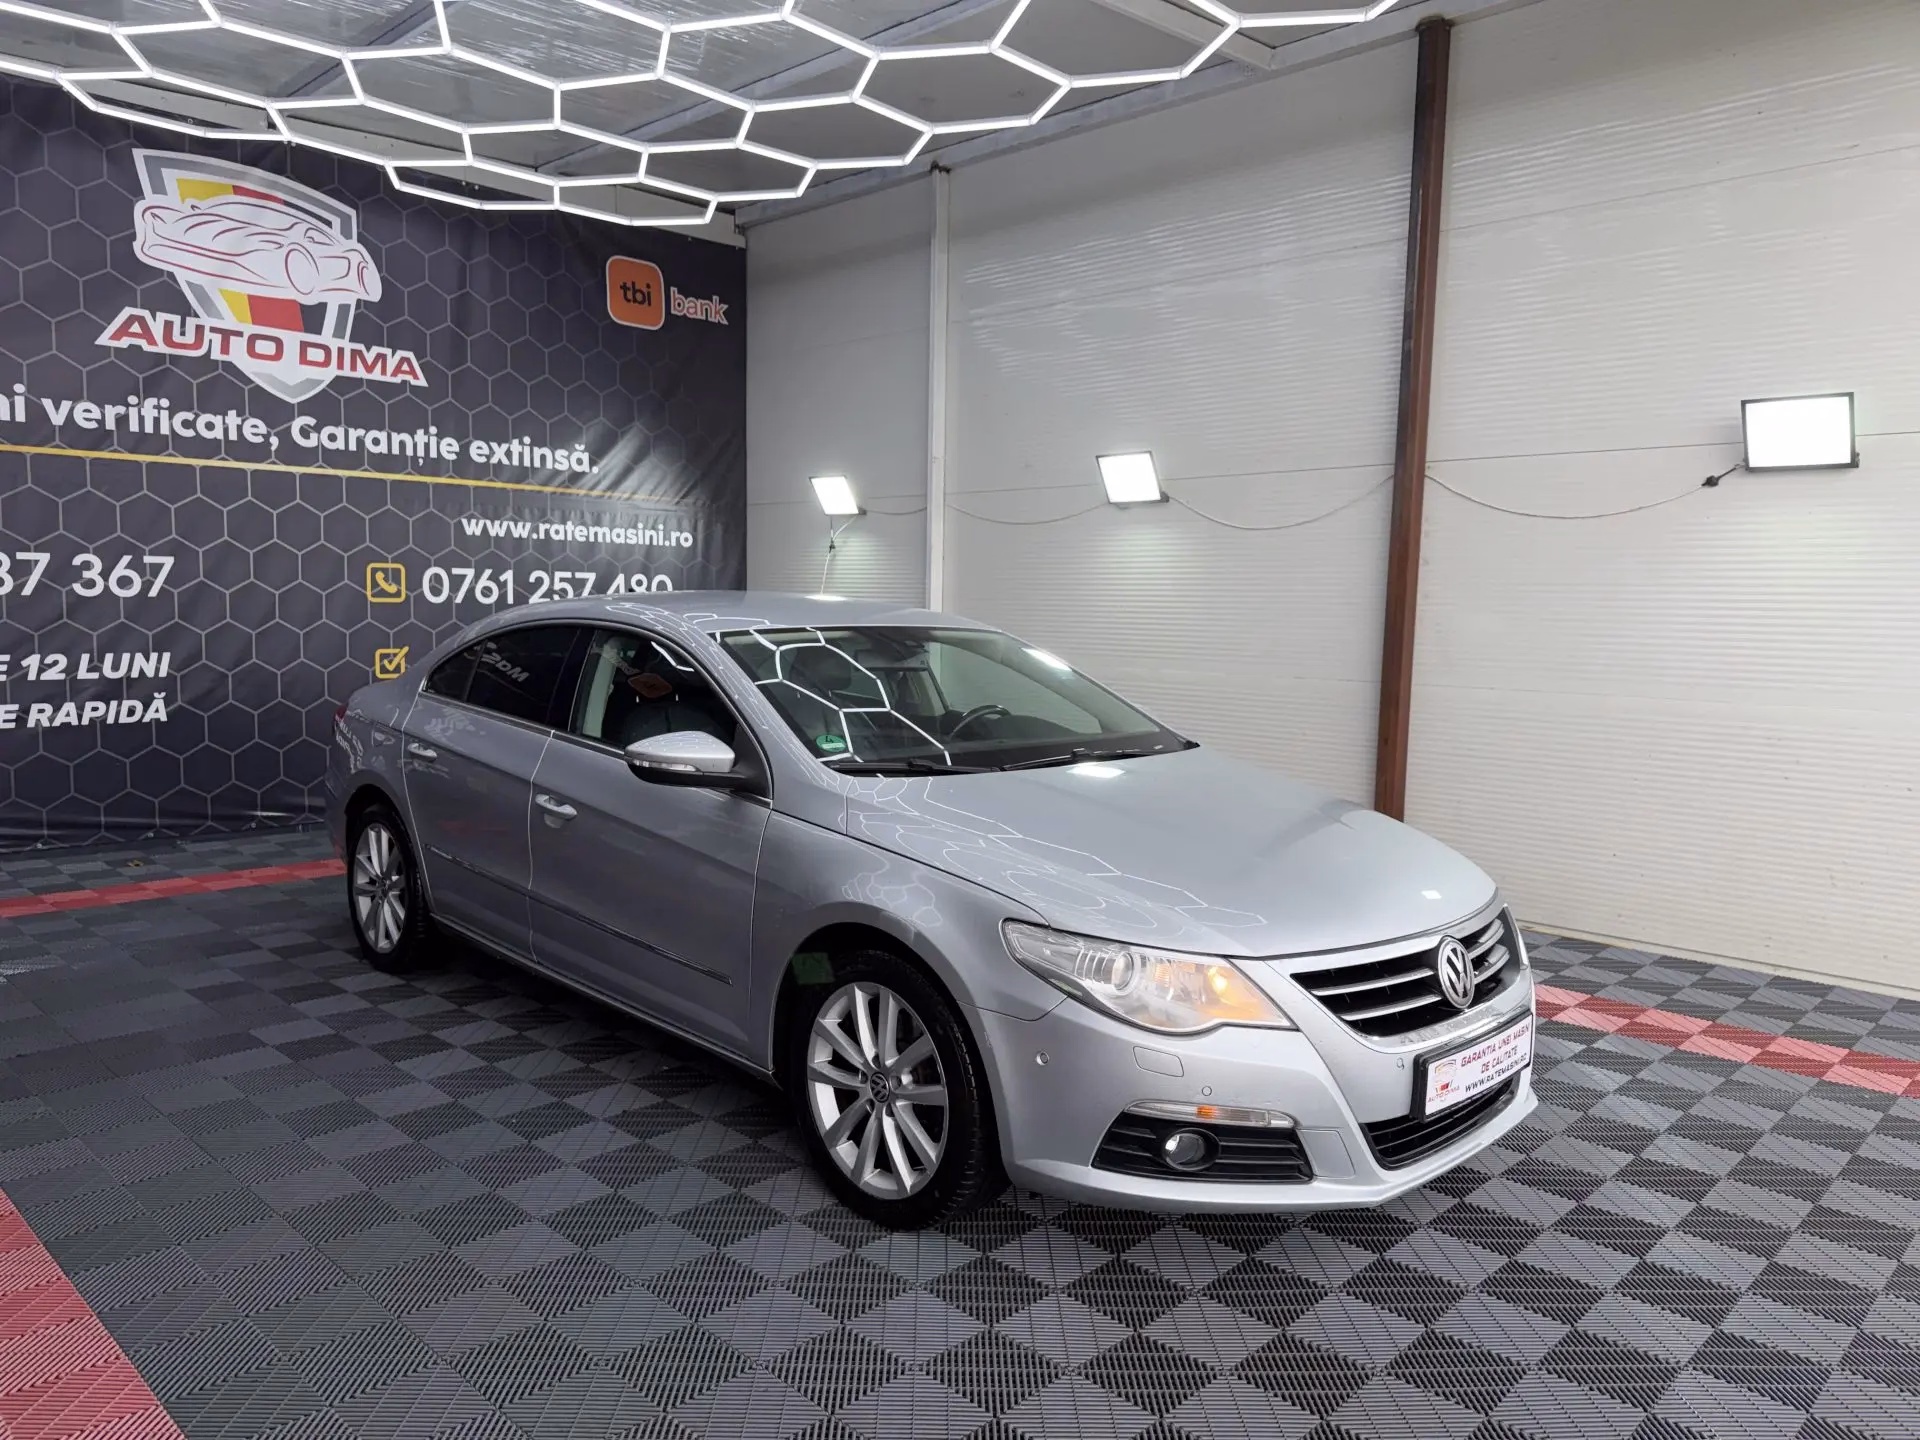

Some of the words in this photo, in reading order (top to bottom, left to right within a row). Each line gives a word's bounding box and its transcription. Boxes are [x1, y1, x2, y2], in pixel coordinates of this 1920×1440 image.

[620, 281, 651, 307] tbi
[670, 286, 729, 325] bank
[107, 313, 284, 362] AUTO
[298, 340, 421, 381] DIMA
[41, 395, 280, 451] verificate,
[291, 415, 460, 466] Garanție
[469, 436, 600, 474] extinsă.
[461, 518, 693, 548] www.ratemasini.ro
[71, 553, 175, 598] 367
[422, 566, 514, 605] 0761
[528, 570, 597, 605] 257
[20, 653, 68, 681] 12
[77, 651, 171, 680] LUNI
[27, 691, 168, 728] RAPIDĂ
[1442, 940, 1472, 1003] VW
[1460, 1043, 1496, 1067] GARANTIA
